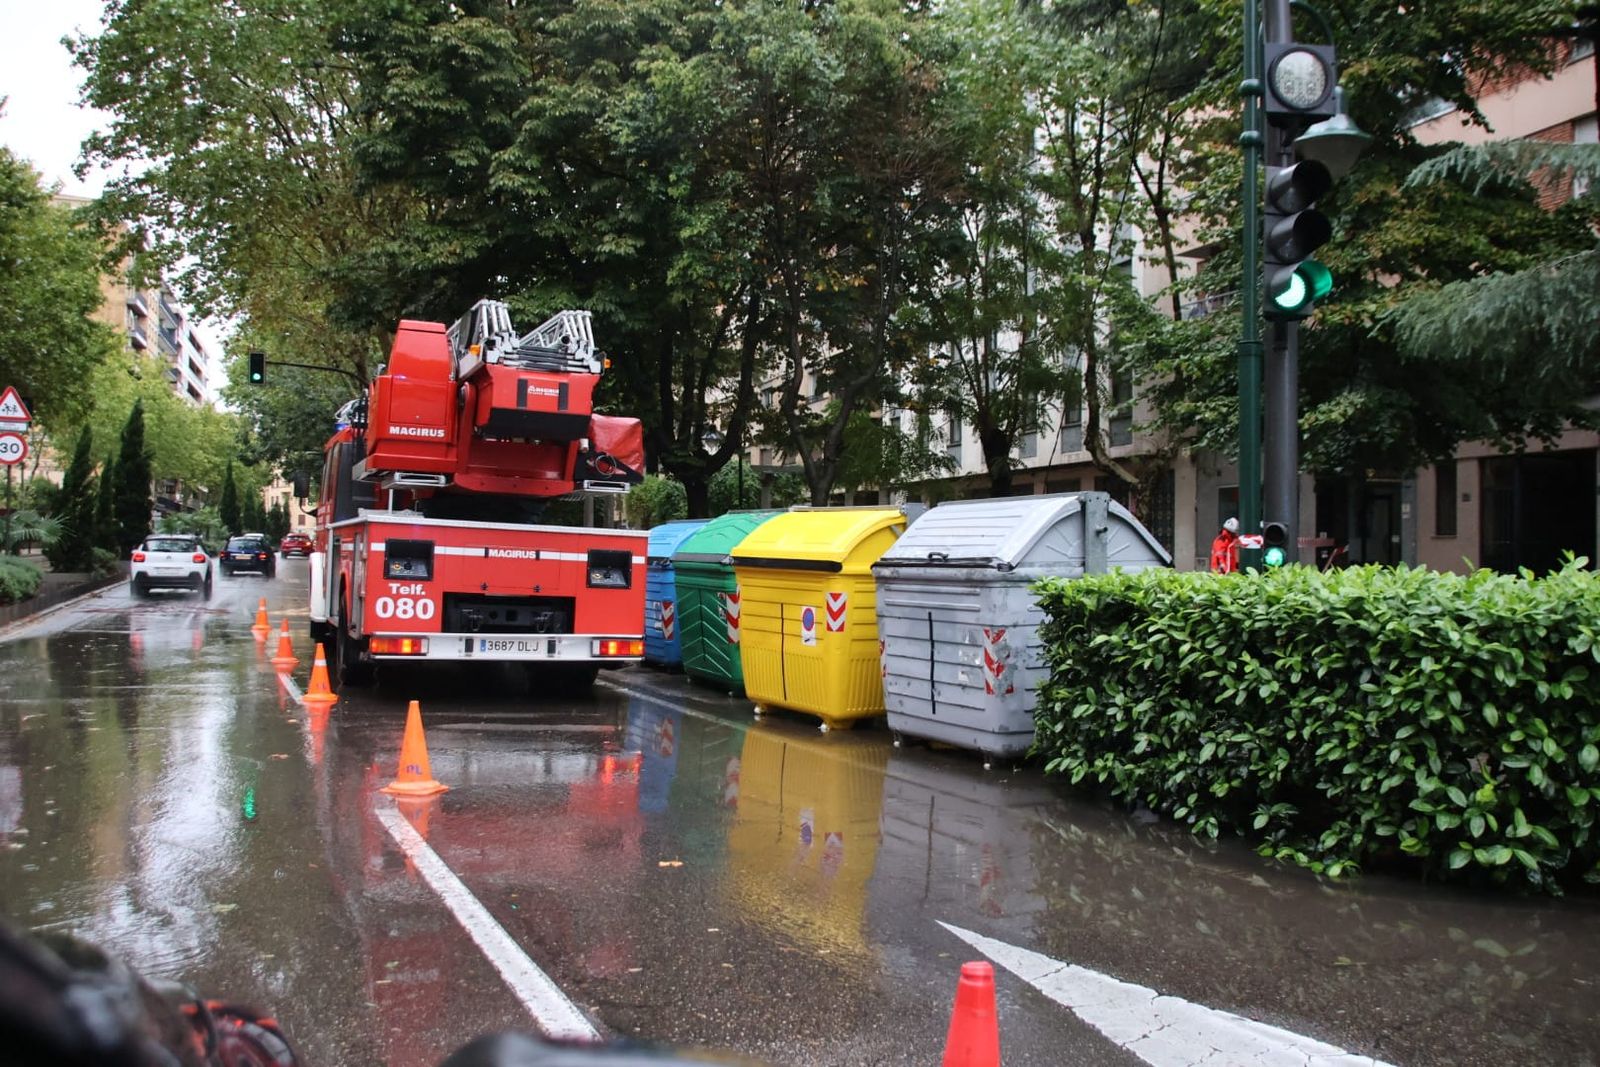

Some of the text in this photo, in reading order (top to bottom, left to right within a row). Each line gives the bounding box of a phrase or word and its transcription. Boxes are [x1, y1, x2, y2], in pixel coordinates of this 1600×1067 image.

[389, 426, 445, 438] MAGIRUS
[0, 442, 20, 454] 30
[488, 548, 537, 559] MAGIRUS
[388, 583, 426, 596] Telf.
[375, 596, 435, 620] 080
[487, 640, 539, 652] 3687 DLJ
